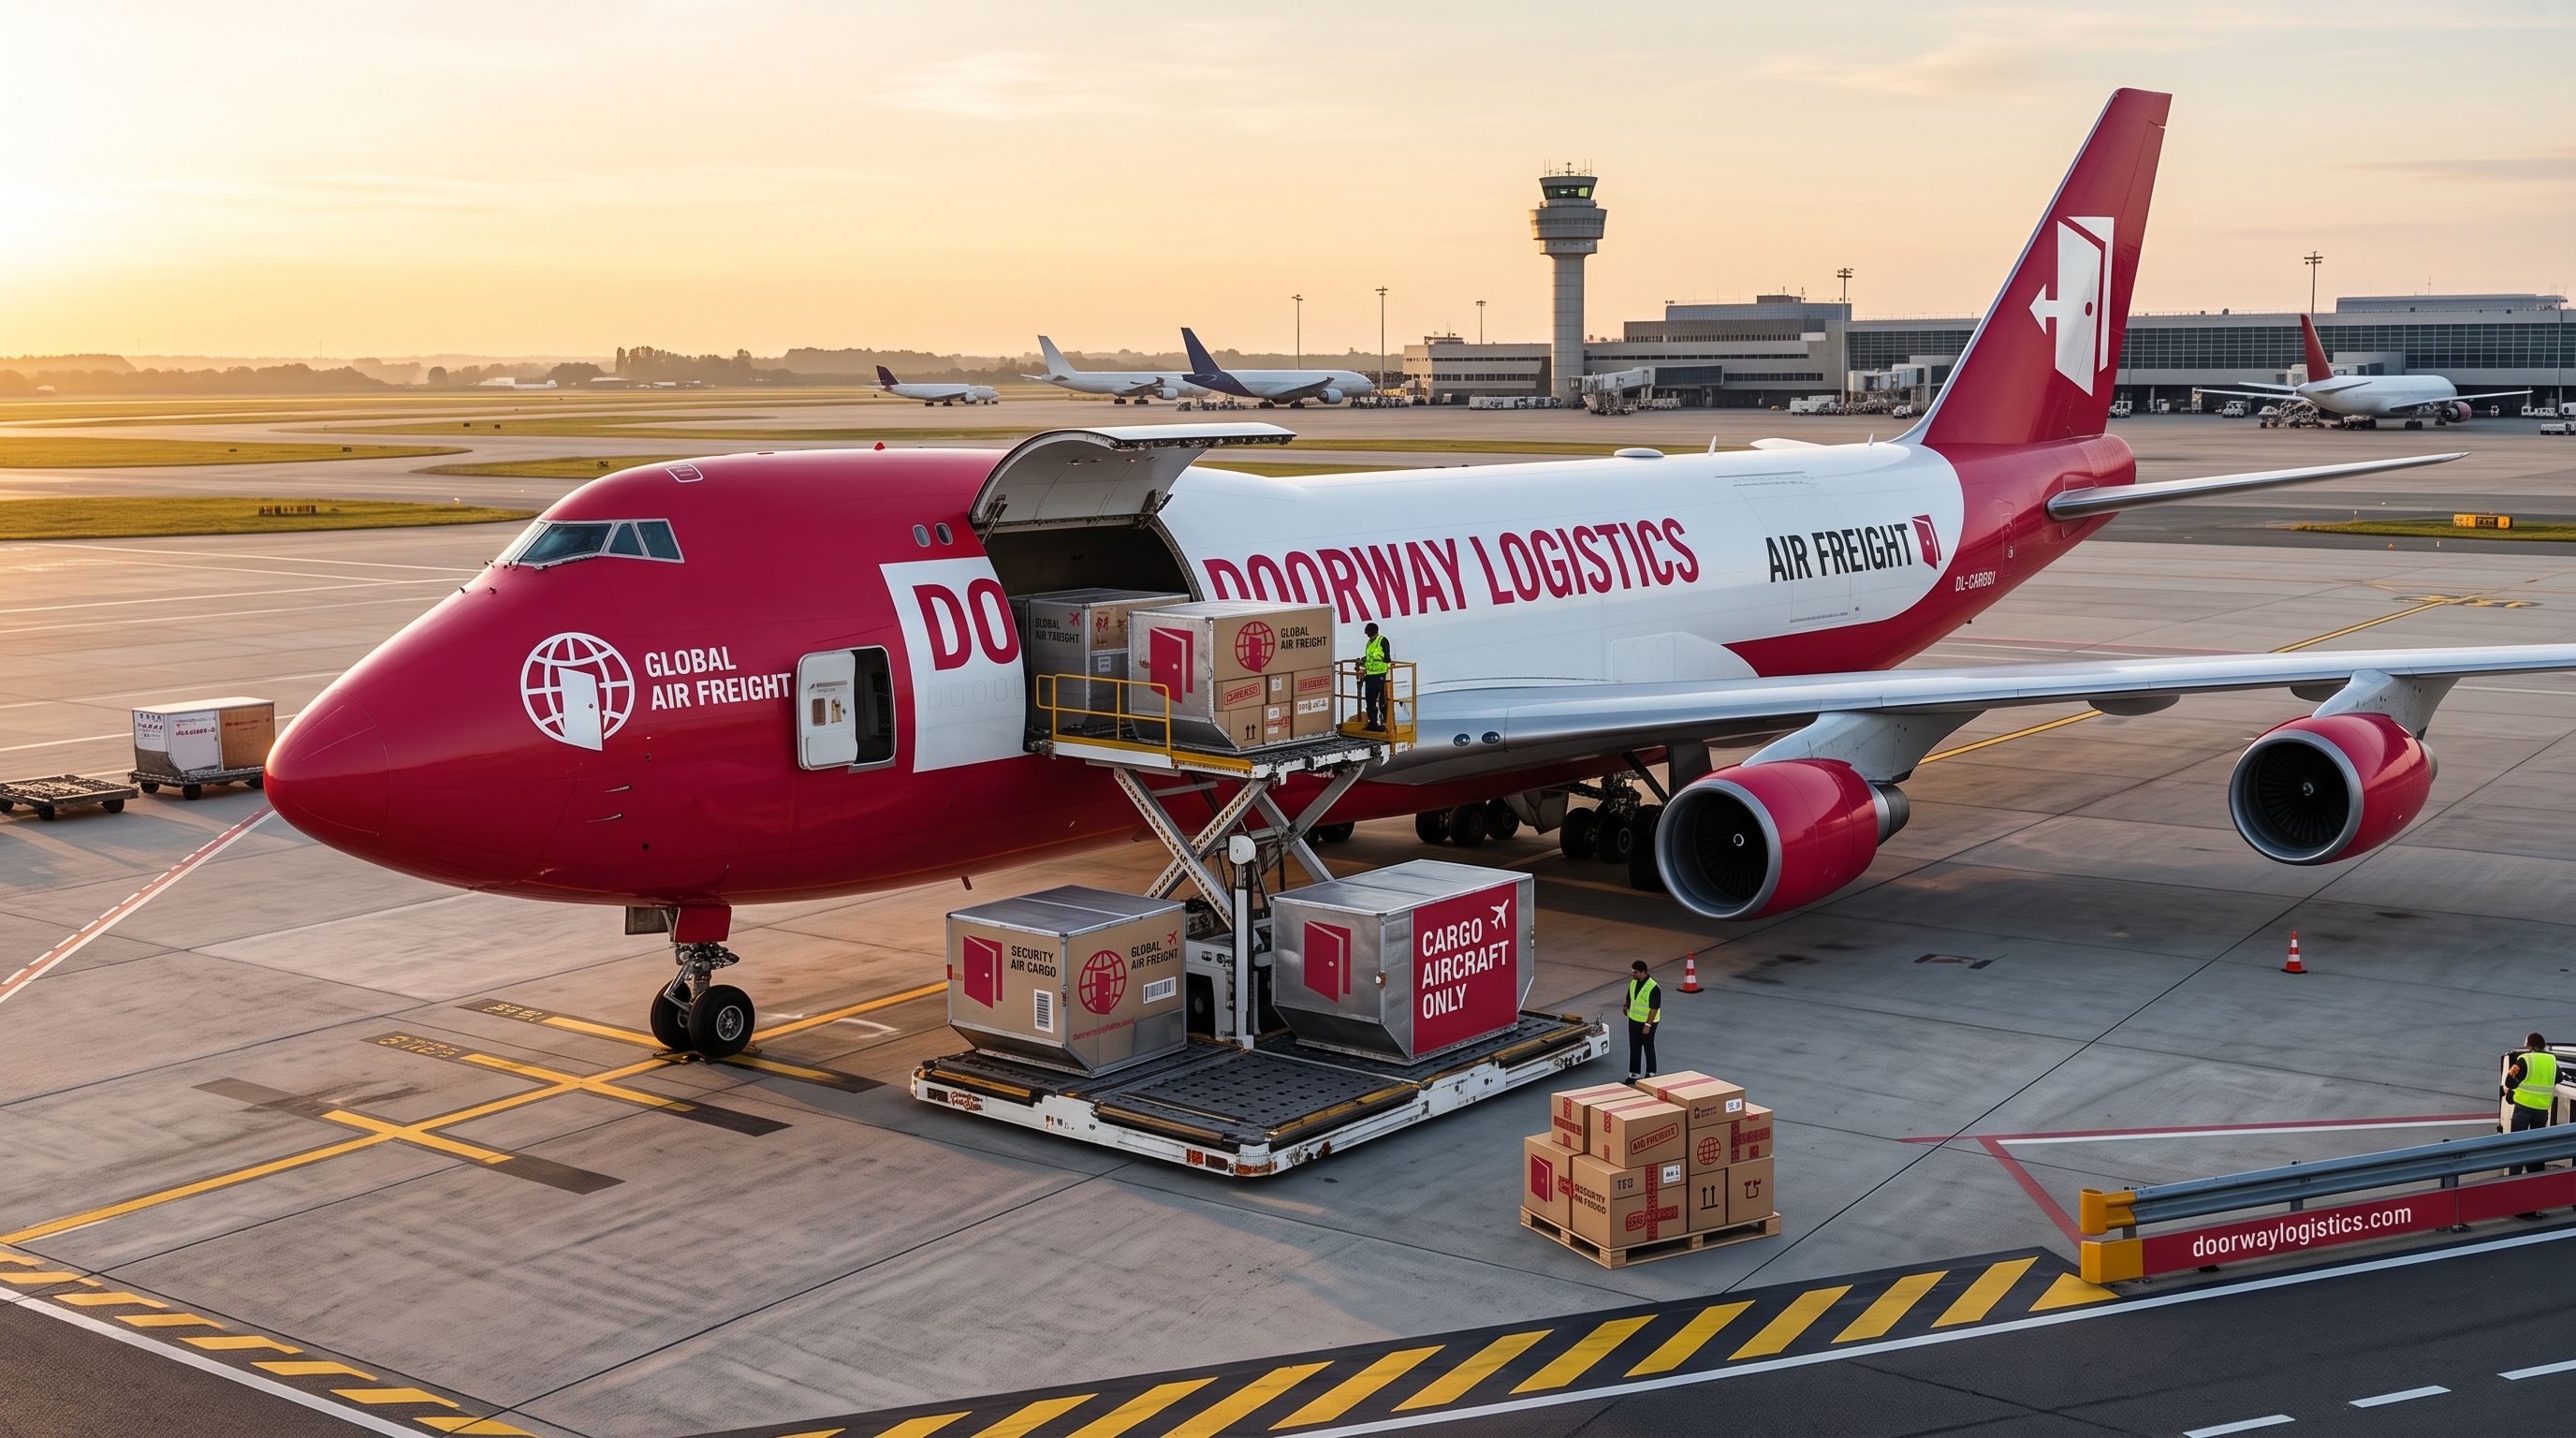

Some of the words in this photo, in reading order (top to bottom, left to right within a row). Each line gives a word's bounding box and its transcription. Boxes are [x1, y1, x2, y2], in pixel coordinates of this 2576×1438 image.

[1468, 518, 1700, 605] LOGISTICS
[1765, 535, 1812, 582] AIR
[1811, 523, 1912, 576] FREIGHT
[912, 578, 1019, 671] DO
[1281, 626, 1310, 638] GLOBAL
[1281, 640, 1294, 650] AIR
[1295, 637, 1327, 648] FREIGHT
[645, 646, 737, 678] GLOBAL
[651, 682, 691, 711] AIR
[696, 673, 791, 706] FREIGHT
[1011, 946, 1054, 963] SECURITY
[1131, 941, 1161, 958] GLOBAL
[1423, 917, 1482, 957] CARGO
[1011, 959, 1025, 972] AIR
[1028, 962, 1056, 977] CARGO
[1131, 958, 1145, 971] AIR
[1146, 947, 1178, 966] FREIGHT
[1422, 940, 1509, 989] AIRCRAFT
[1423, 983, 1467, 1019] ONLY
[2192, 1207, 2412, 1257] doorwaylogistics.com
